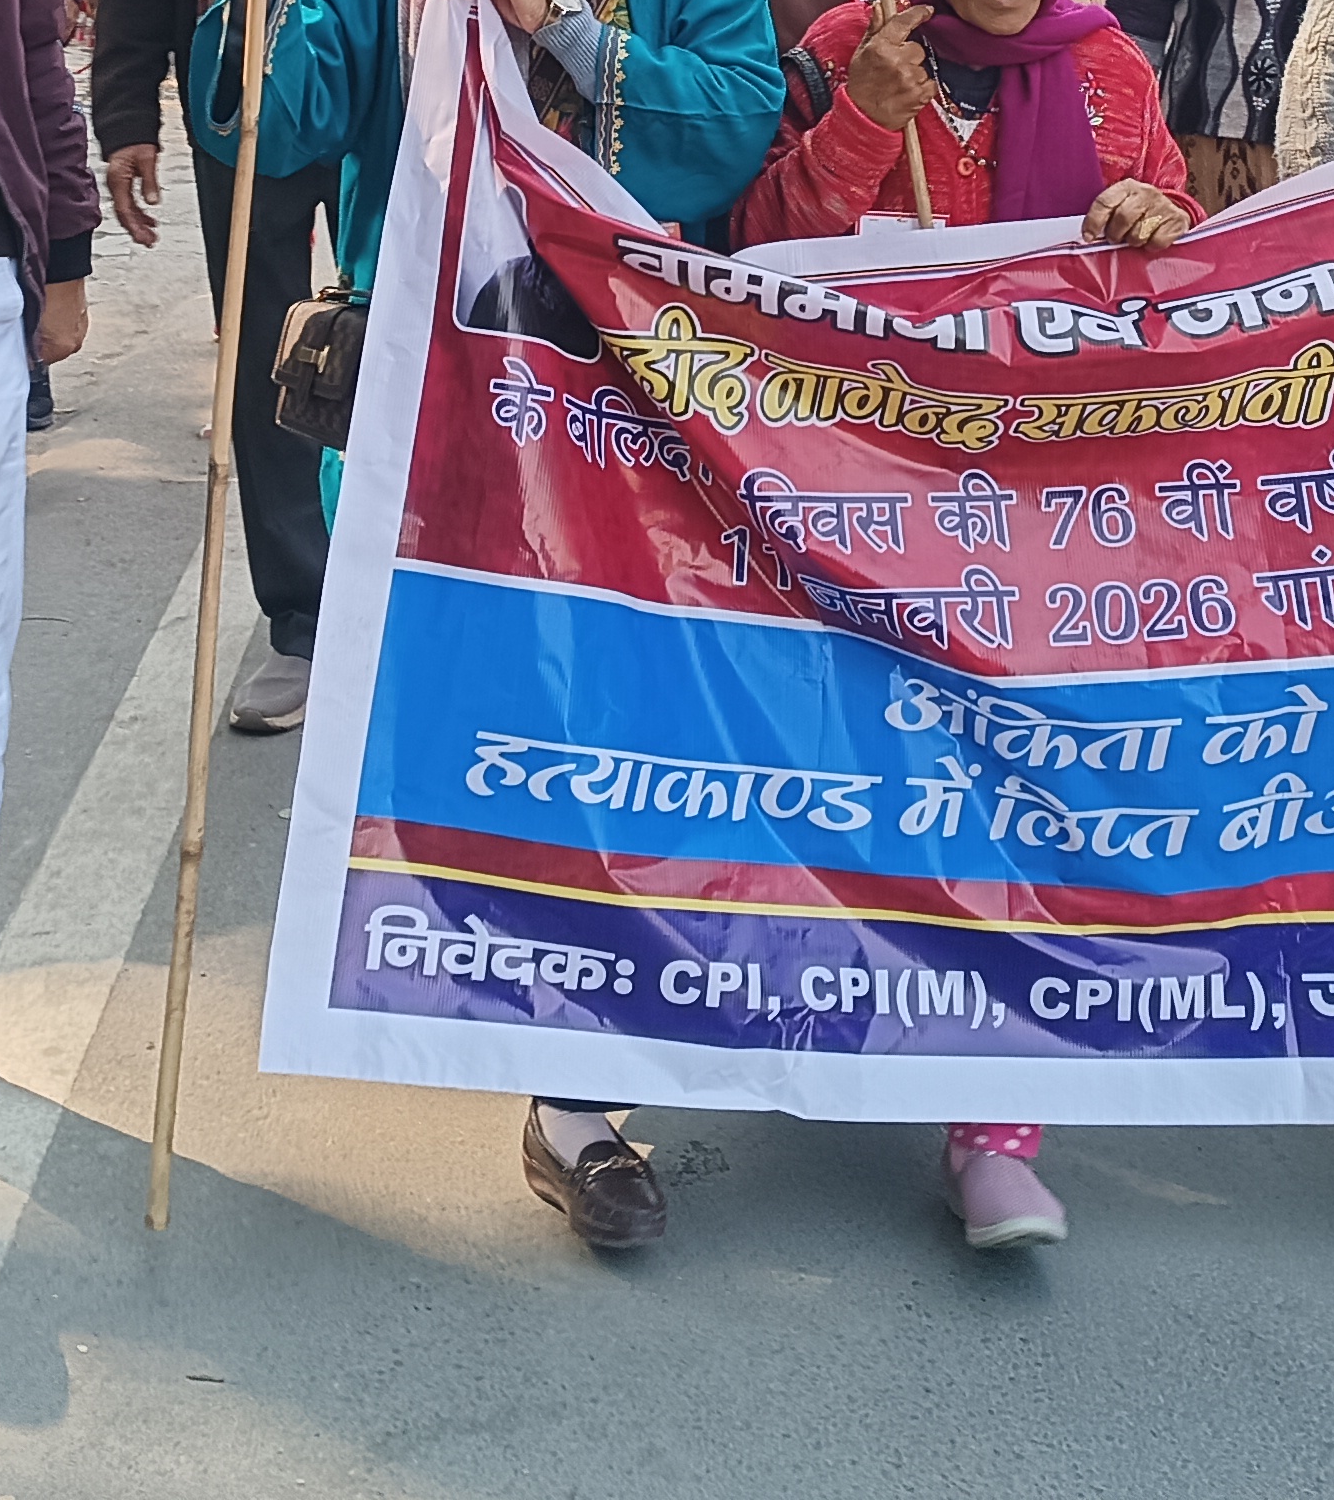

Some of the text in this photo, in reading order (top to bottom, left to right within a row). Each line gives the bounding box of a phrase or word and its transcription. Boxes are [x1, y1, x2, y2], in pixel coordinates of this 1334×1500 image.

[1012, 299, 1146, 352] एवं
[605, 304, 757, 432] हीद
[762, 362, 1005, 449] नागेन्द्र
[490, 357, 554, 447] के
[563, 386, 713, 486] बलिद
[738, 467, 911, 554] दिवस
[928, 468, 1016, 553] की
[1041, 485, 1134, 550] 76
[1155, 457, 1241, 542] वीं
[798, 565, 1019, 650] जनवरी
[1046, 575, 1235, 648] 2026
[884, 675, 1185, 774] अंकिता
[1201, 683, 1330, 768] को
[466, 730, 883, 833] हत्याकाण्ड
[898, 756, 982, 839] में
[990, 775, 1199, 861] लिप्त
[659, 959, 784, 1022] CPI,
[799, 965, 1007, 1030] CPI(M),
[1029, 971, 1287, 1031] CPI(ML),
